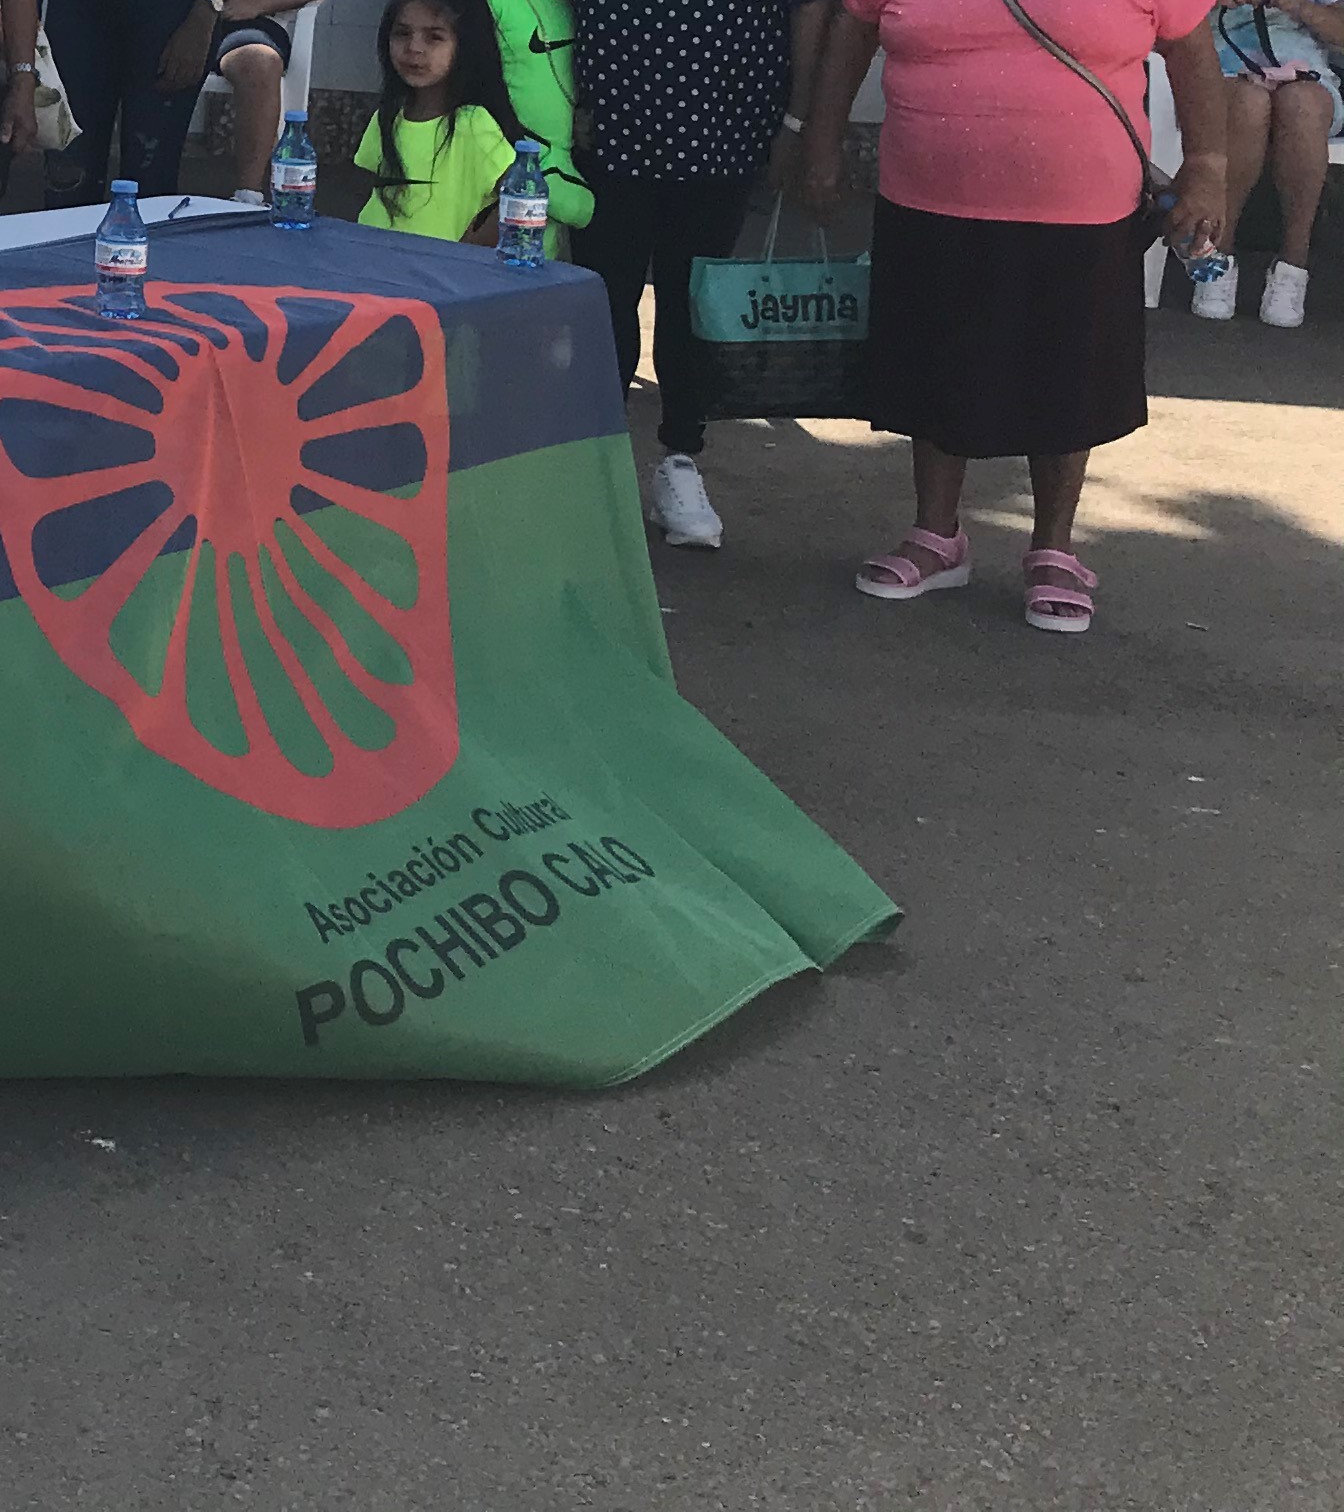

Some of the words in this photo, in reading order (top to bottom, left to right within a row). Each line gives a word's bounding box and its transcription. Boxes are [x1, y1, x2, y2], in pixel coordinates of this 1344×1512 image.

[740, 289, 859, 330] jayma
[304, 836, 485, 944] Asociación
[295, 869, 561, 1048] POCHIBO
